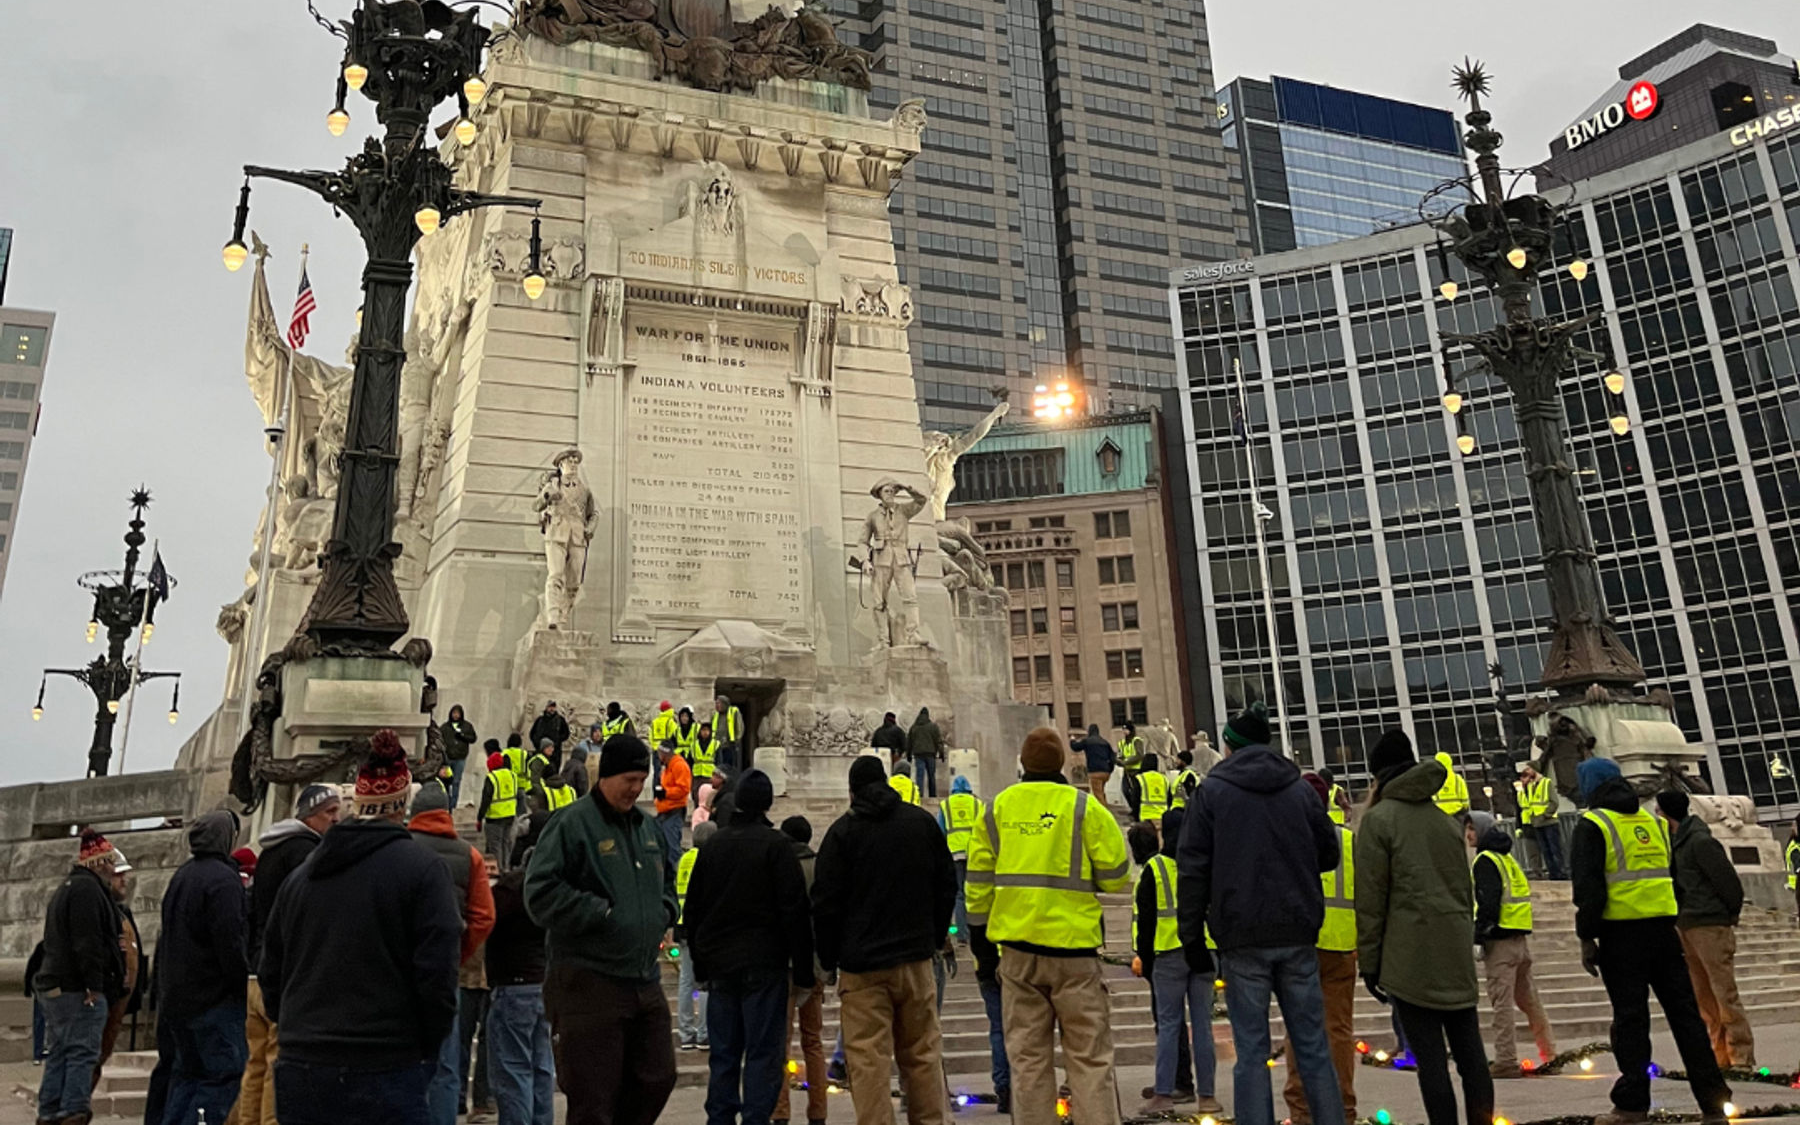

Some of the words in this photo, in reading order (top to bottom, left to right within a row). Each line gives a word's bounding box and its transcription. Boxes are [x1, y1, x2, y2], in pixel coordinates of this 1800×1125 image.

[1564, 102, 1624, 150] BMO
[1730, 103, 1800, 146] CHASE
[628, 251, 646, 264] TO
[1183, 261, 1254, 281] salesforce
[635, 326, 668, 340] WAR
[674, 329, 704, 343] FOR
[710, 333, 739, 346] THE
[744, 338, 789, 352] UNION
[641, 375, 695, 391] INDIANA
[699, 381, 785, 399] VOLUNTEERS
[653, 398, 703, 410] REGIMENTS
[706, 404, 748, 414] INFANTRY
[653, 408, 703, 420] REGIMENTS
[707, 413, 746, 423] CAVALRY
[653, 424, 698, 435] REGIMENT
[707, 430, 754, 441] ARTILLERY
[653, 435, 703, 446] COMPANIES
[712, 440, 761, 451] ARTILLERY
[652, 452, 675, 460] NAVY
[707, 467, 742, 478] TOTAL
[631, 503, 673, 518] INDIANA
[676, 506, 686, 518] IN
[688, 507, 709, 520] THE
[711, 509, 733, 522] WAR
[736, 511, 763, 524] WITH
[729, 589, 758, 600] TOTAL
[359, 797, 408, 817] IBEW
